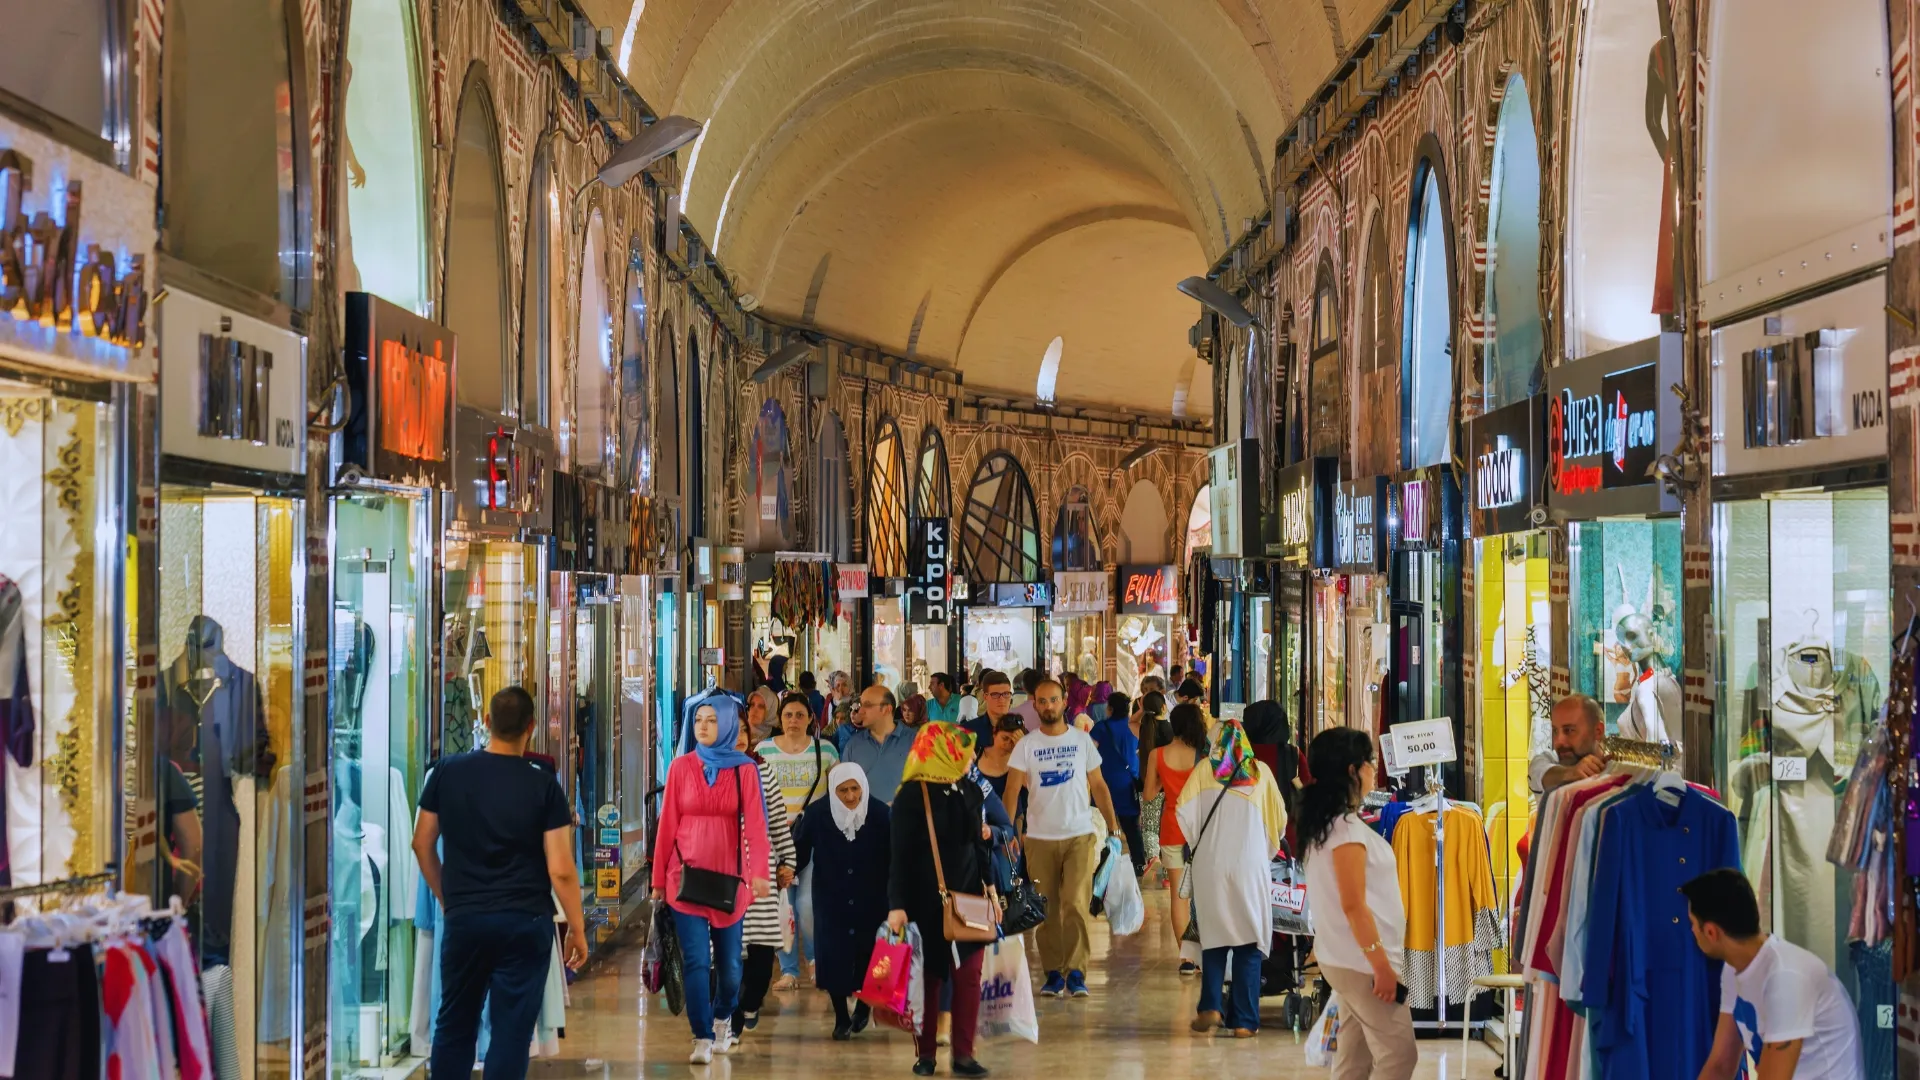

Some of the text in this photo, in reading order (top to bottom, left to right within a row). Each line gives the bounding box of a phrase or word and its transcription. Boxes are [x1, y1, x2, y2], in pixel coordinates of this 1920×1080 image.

[1562, 388, 1602, 459] Bursa
[1853, 389, 1884, 430] MODA
[926, 522, 944, 620] kupon
[1407, 742, 1436, 753] 50,00
